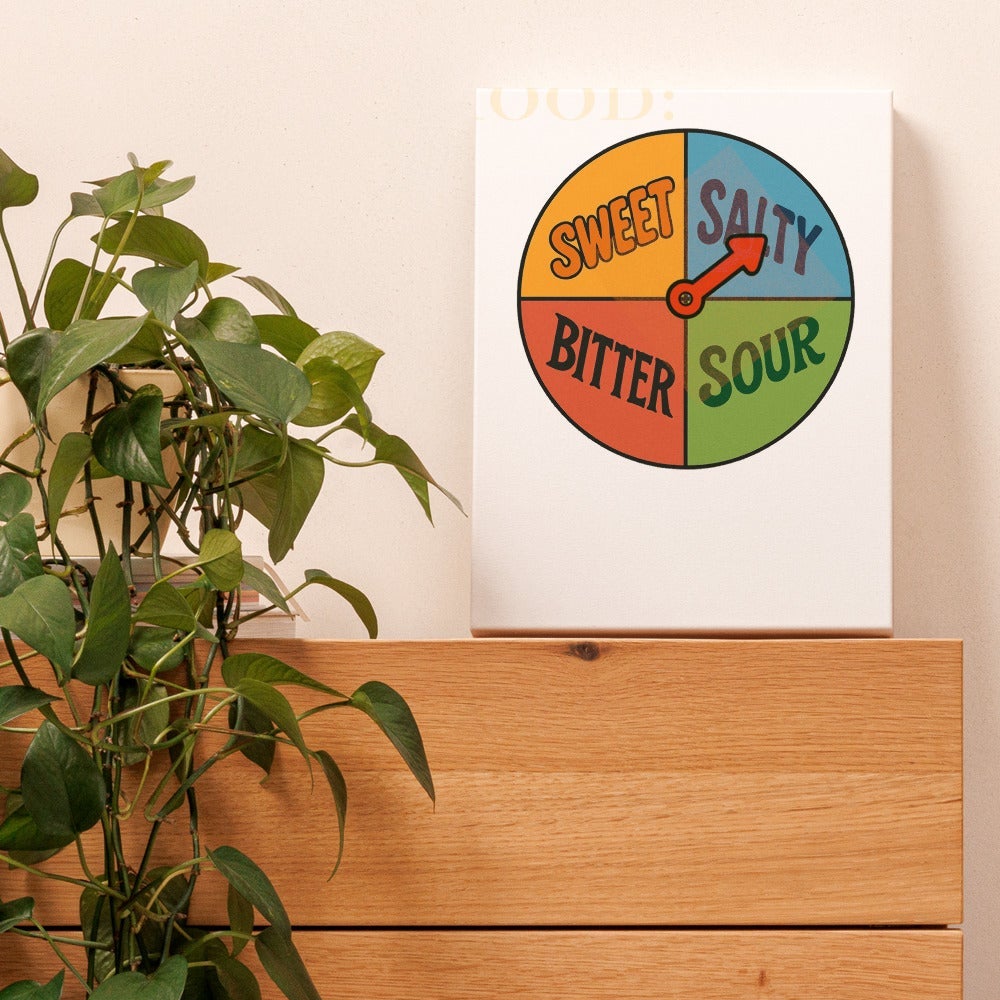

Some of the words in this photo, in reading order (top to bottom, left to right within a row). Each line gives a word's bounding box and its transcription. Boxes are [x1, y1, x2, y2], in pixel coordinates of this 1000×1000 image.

[476, 88, 674, 121] OOD:
[548, 176, 676, 280] SWEET
[696, 178, 823, 276] SALTY
[545, 312, 676, 419] BITTER
[698, 316, 825, 408] SOUR
